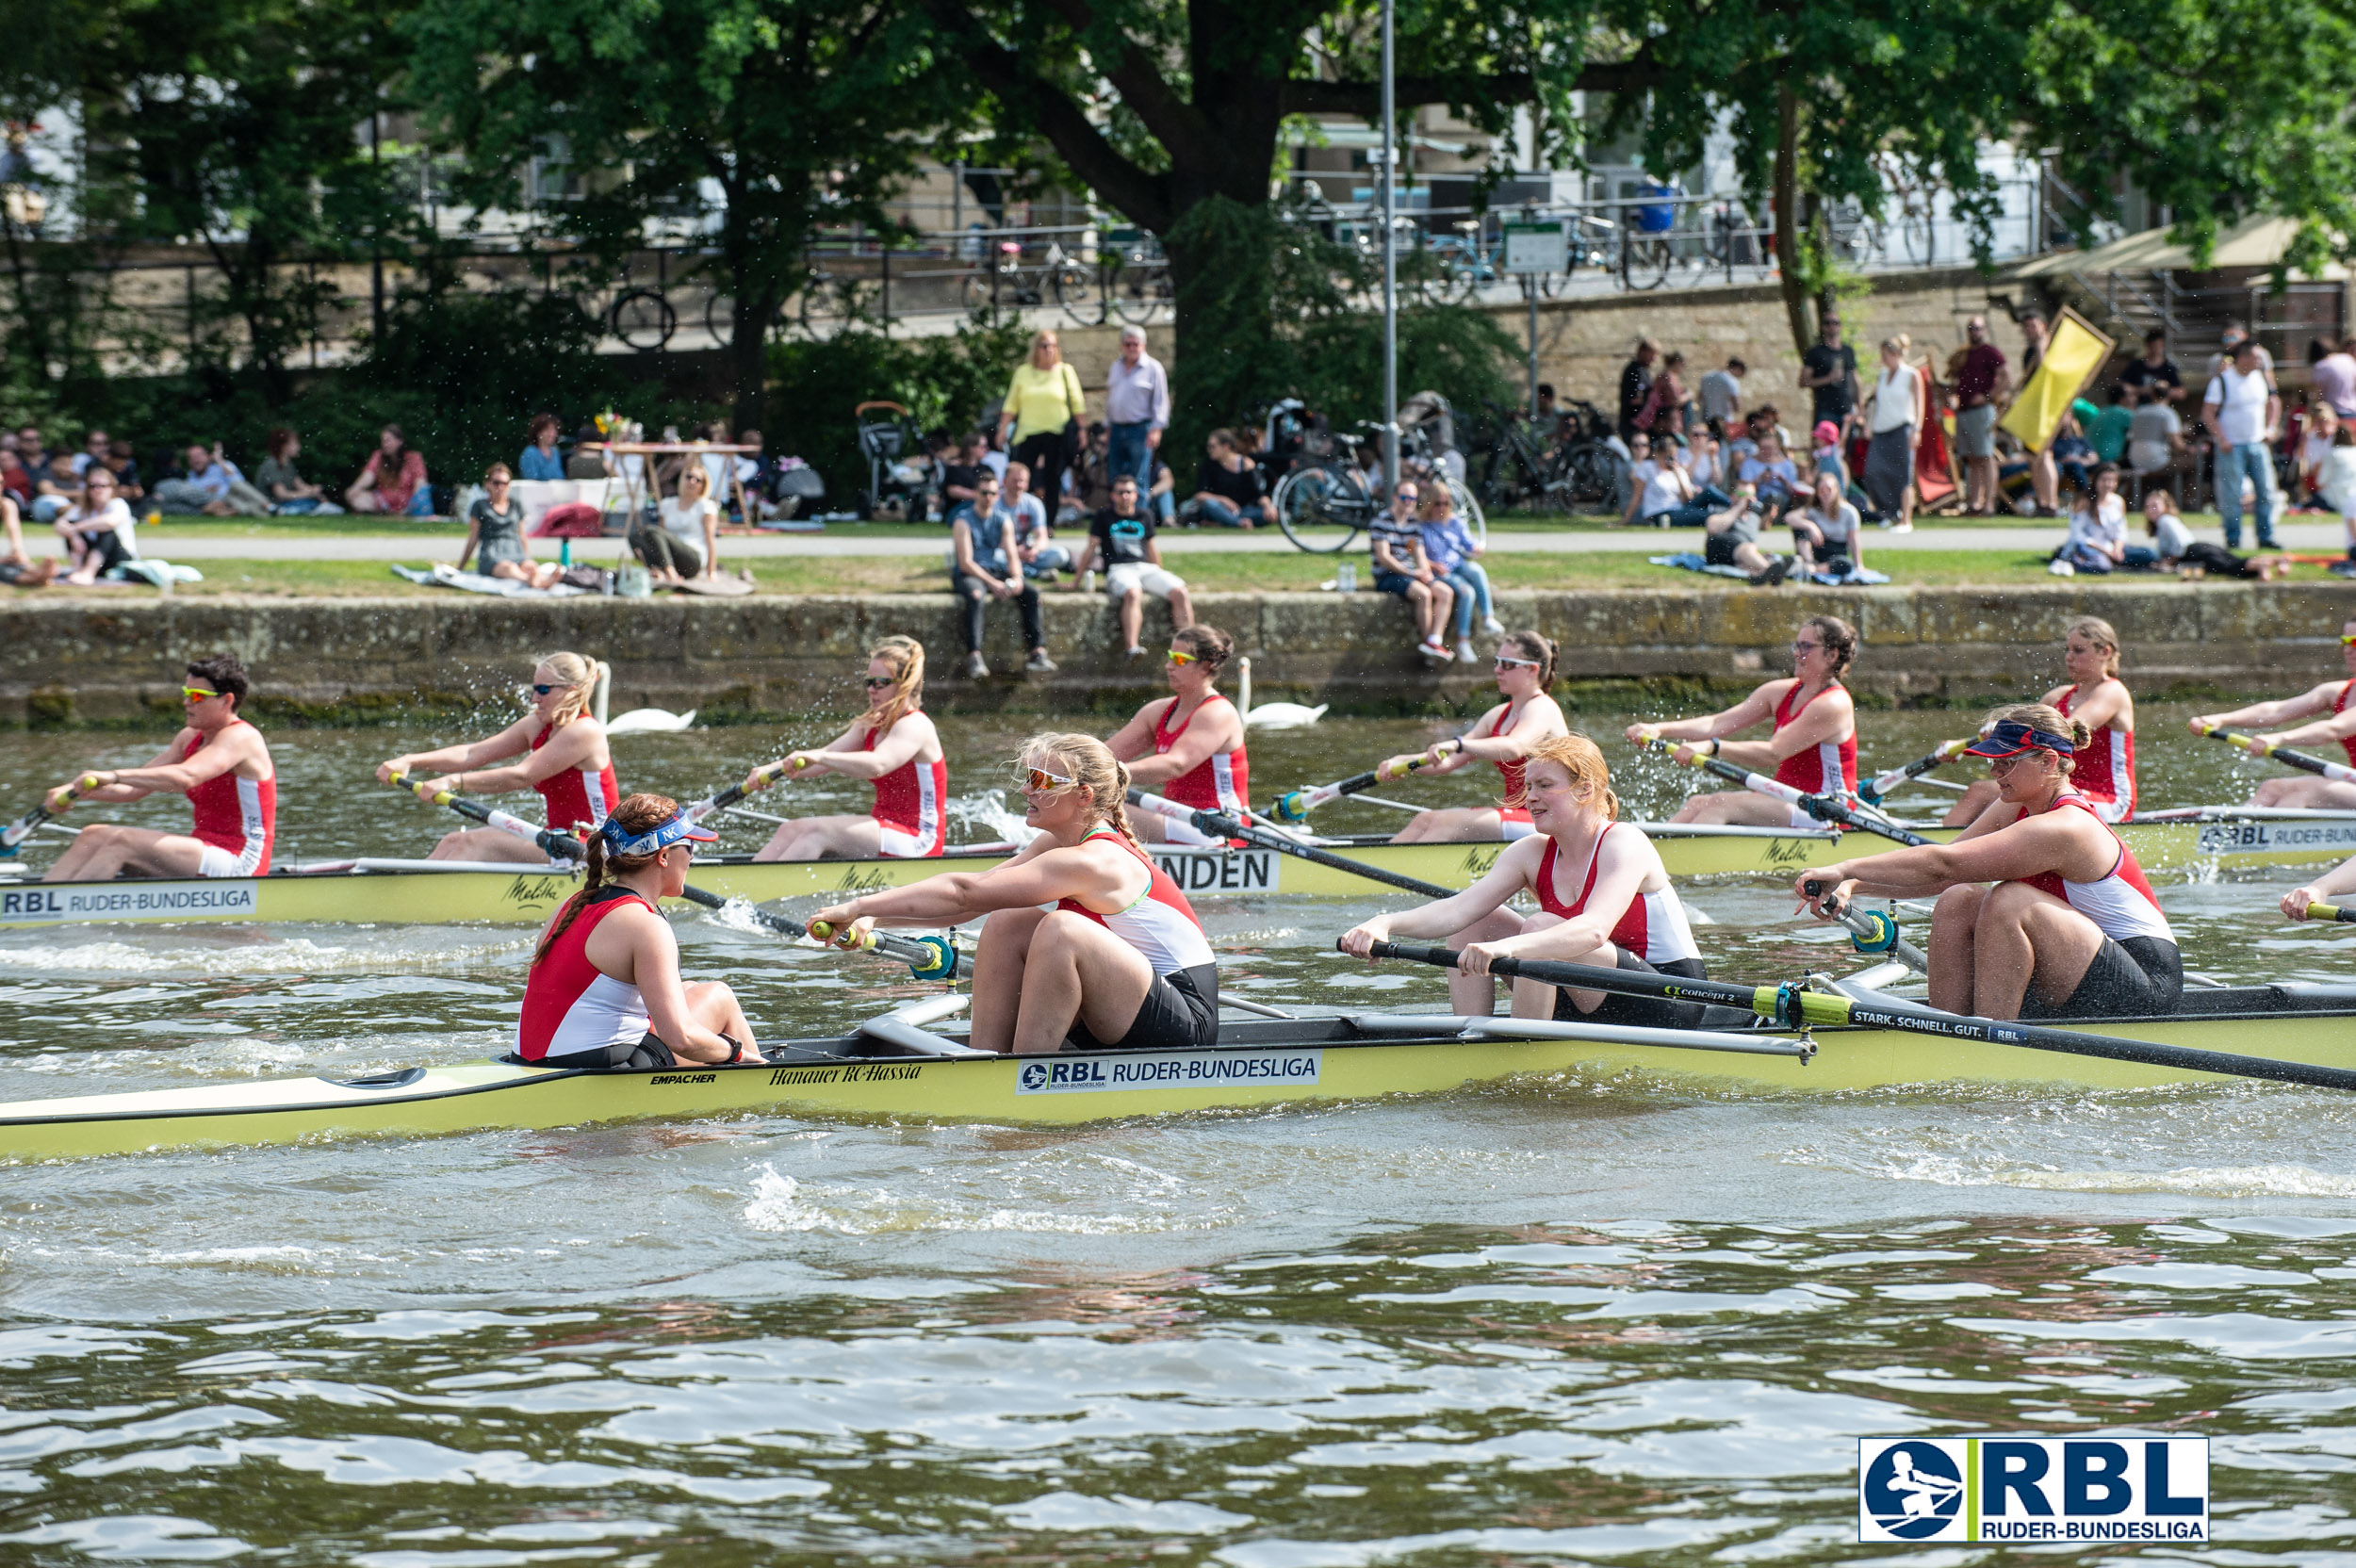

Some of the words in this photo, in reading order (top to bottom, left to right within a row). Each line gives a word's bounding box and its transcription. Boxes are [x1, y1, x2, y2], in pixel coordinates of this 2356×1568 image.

[662, 827, 679, 841] NK
[1152, 854, 1269, 890] NDEN
[5, 891, 63, 913] RBL
[70, 890, 251, 911] RUDER-BUNDESLIGA
[1681, 988, 1726, 1001] concept
[1855, 1011, 1895, 1026] STARK.
[1897, 1017, 1953, 1034] SCHNELL.
[1955, 1024, 1982, 1037] GUT.
[1997, 1029, 2020, 1040] RBL
[650, 1074, 716, 1086] EMPACHER
[769, 1069, 841, 1086] Hanauer
[1051, 1062, 1106, 1083] RBL
[1113, 1058, 1316, 1083] RUDER-BUNDESLIGA
